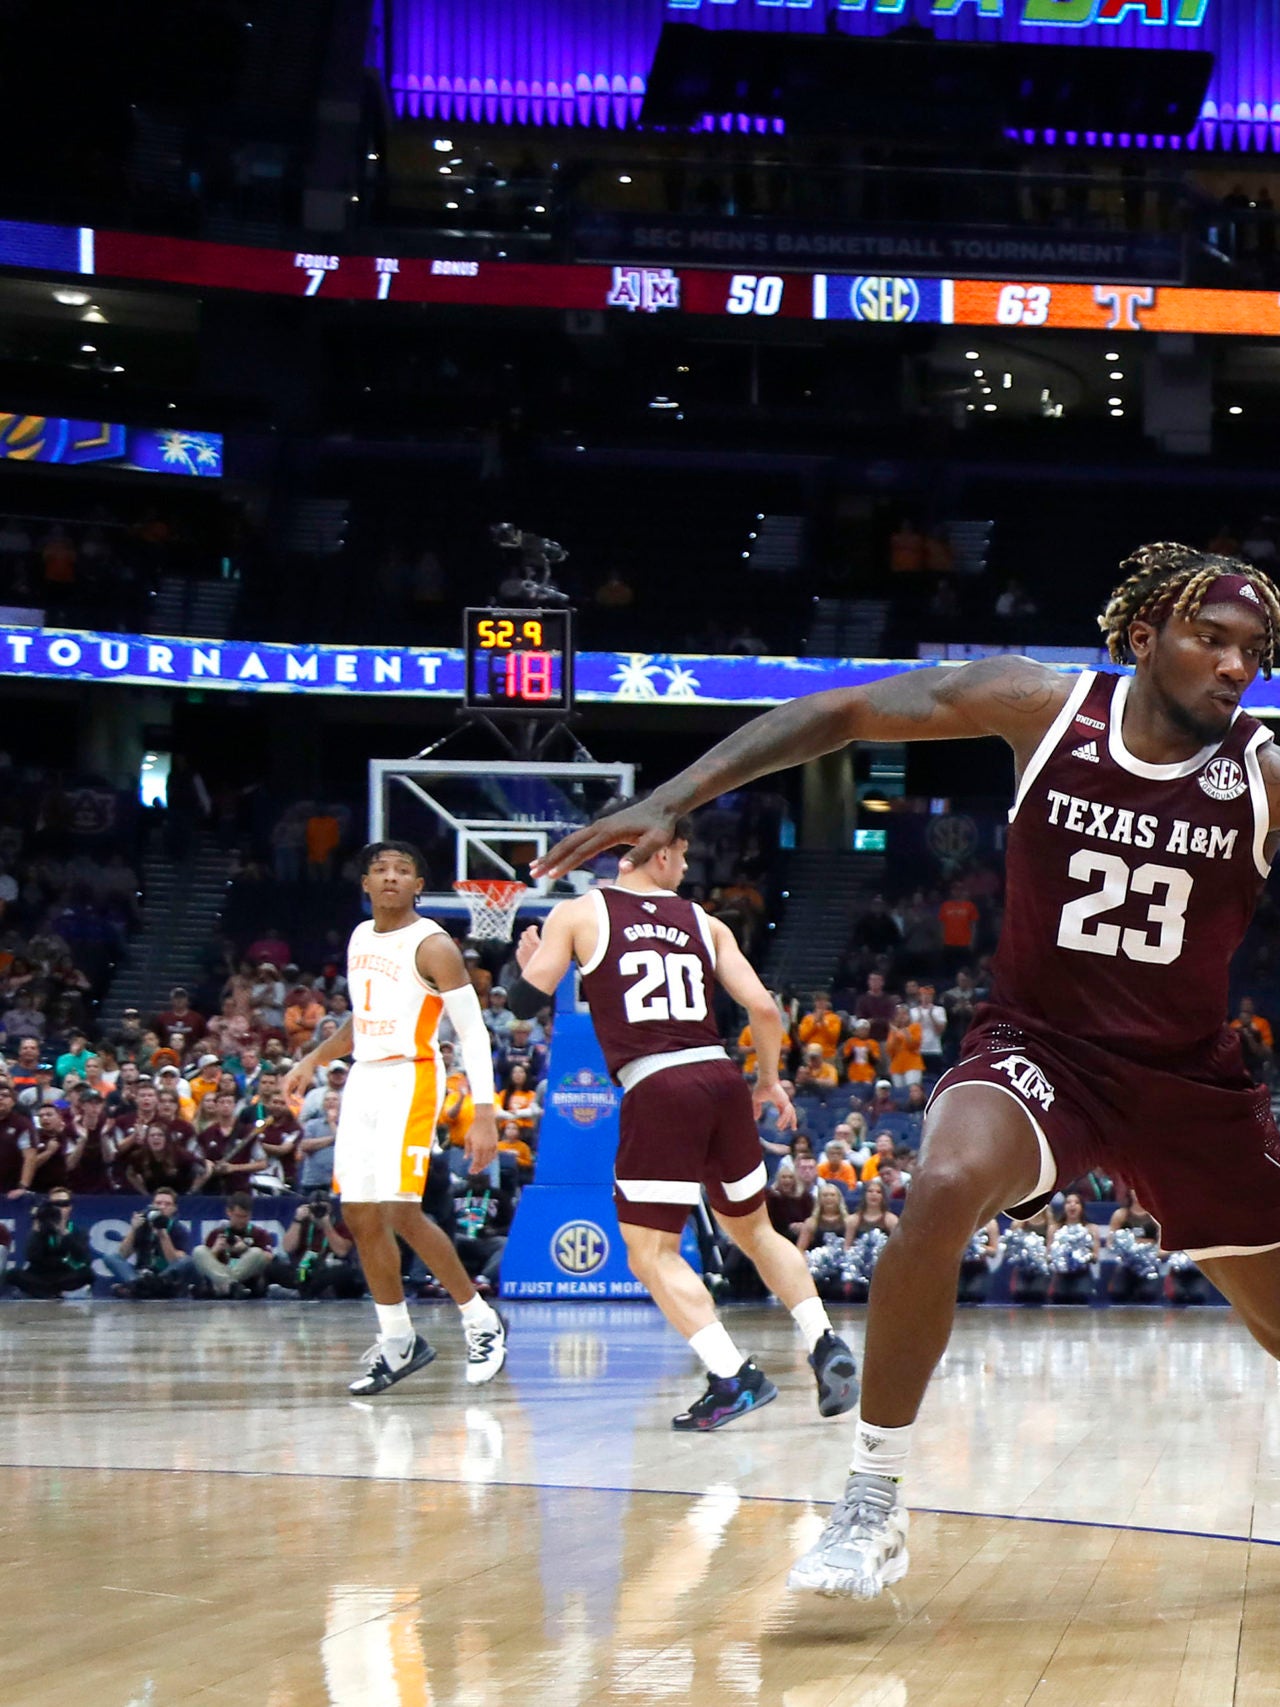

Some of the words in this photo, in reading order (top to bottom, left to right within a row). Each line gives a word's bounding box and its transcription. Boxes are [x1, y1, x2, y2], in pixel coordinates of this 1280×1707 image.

[633, 227, 682, 248] SEC
[690, 230, 768, 253] MEN'S
[776, 234, 944, 256] BASKETBALL
[951, 238, 1126, 263] TOURNAMENT
[294, 253, 341, 270] FOULS
[431, 260, 479, 276] BONUS
[304, 269, 326, 297] 7
[377, 272, 392, 300] 1
[726, 274, 784, 315] 50
[860, 275, 911, 322] SEC
[997, 284, 1051, 325] 63
[477, 619, 542, 648] 52.9
[7, 636, 442, 685] TOURNAMENT
[505, 650, 552, 701] 18
[1071, 749, 1100, 764] adidas
[1201, 781, 1241, 801] GRADUATE
[1208, 759, 1240, 790] SEC
[1046, 789, 1159, 849] TEXAS
[1165, 819, 1239, 860] A&M
[1056, 848, 1195, 966] 23
[623, 923, 691, 948] GORDON
[349, 953, 402, 983] ENNESSEE
[363, 978, 372, 1012] 1
[618, 949, 709, 1024] 20
[407, 1145, 430, 1177] T
[557, 1226, 602, 1271] SEC
[503, 1281, 516, 1293] IT
[519, 1281, 553, 1294] JUST
[557, 1281, 606, 1294] MEANS
